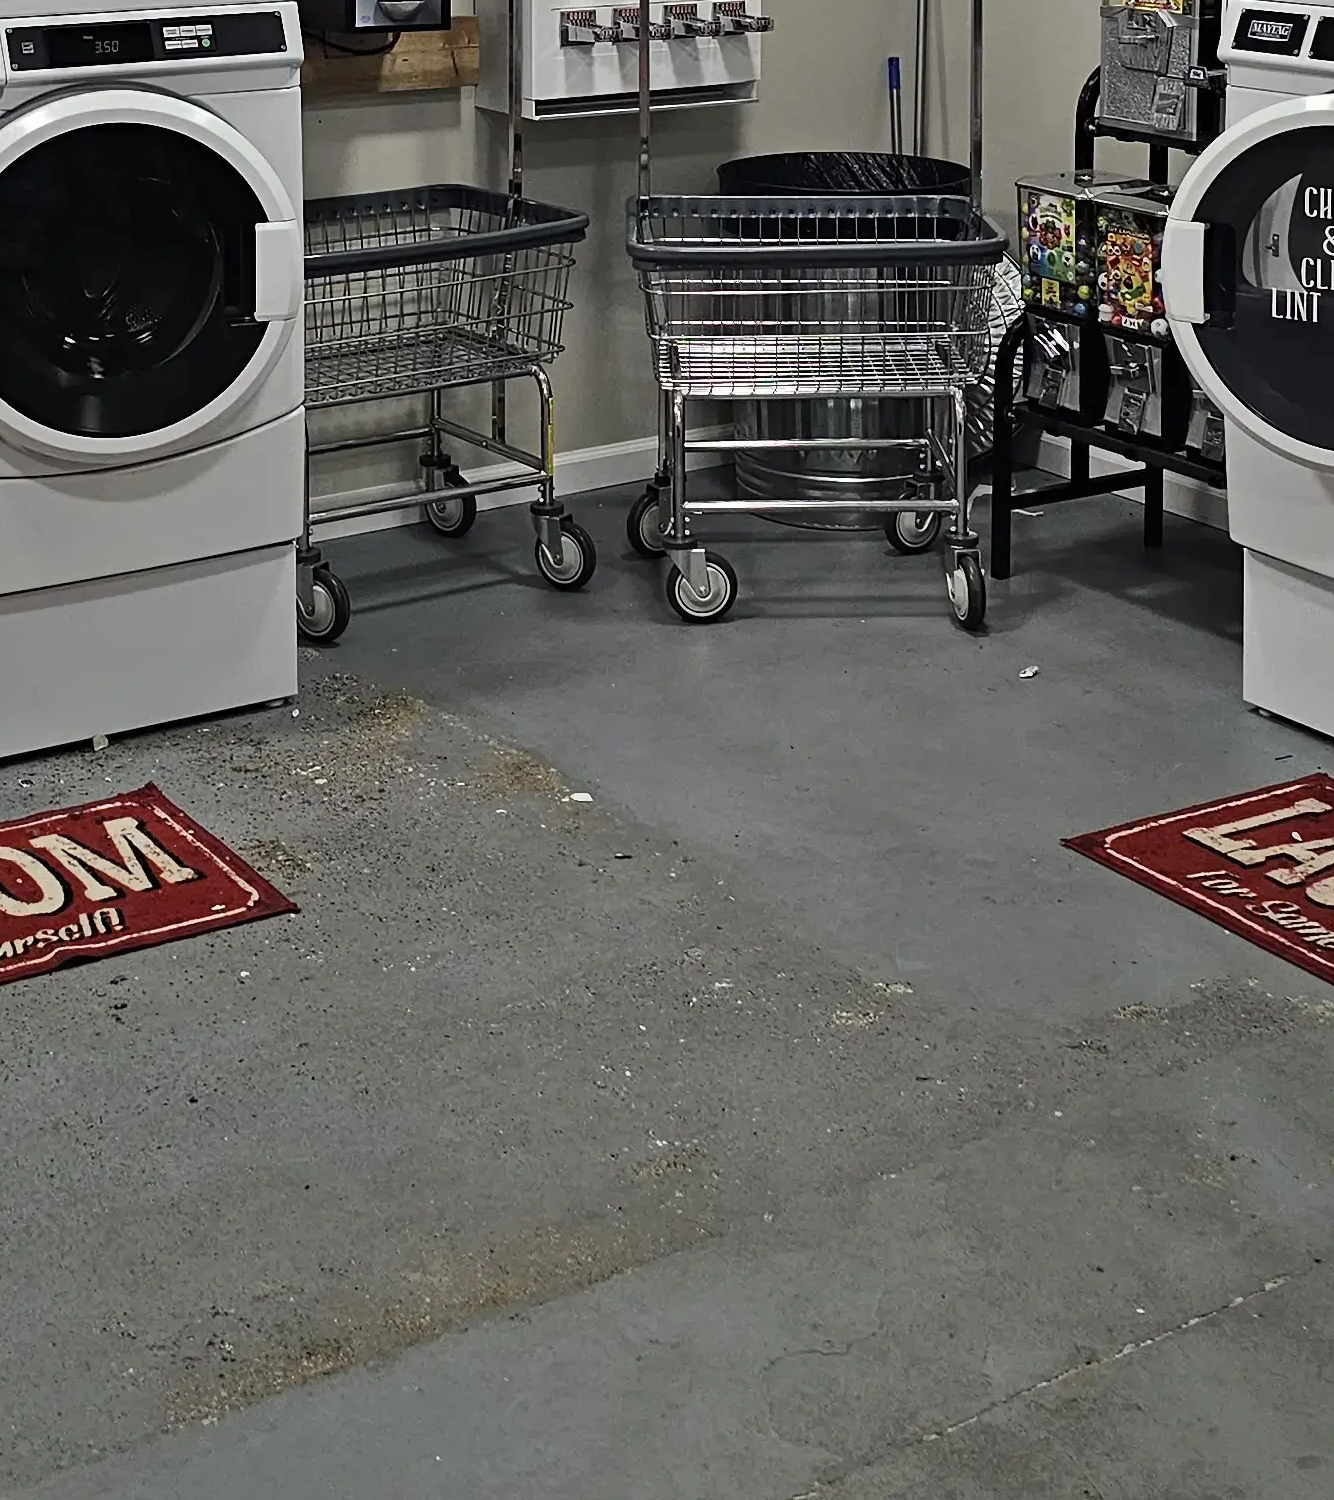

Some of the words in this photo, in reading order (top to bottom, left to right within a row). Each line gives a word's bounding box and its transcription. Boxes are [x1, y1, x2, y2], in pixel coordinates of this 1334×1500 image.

[1252, 23, 1290, 35] MAYTAG
[94, 40, 119, 54] 3.50
[1271, 287, 1322, 323] LINT
[1186, 870, 1258, 900] For
